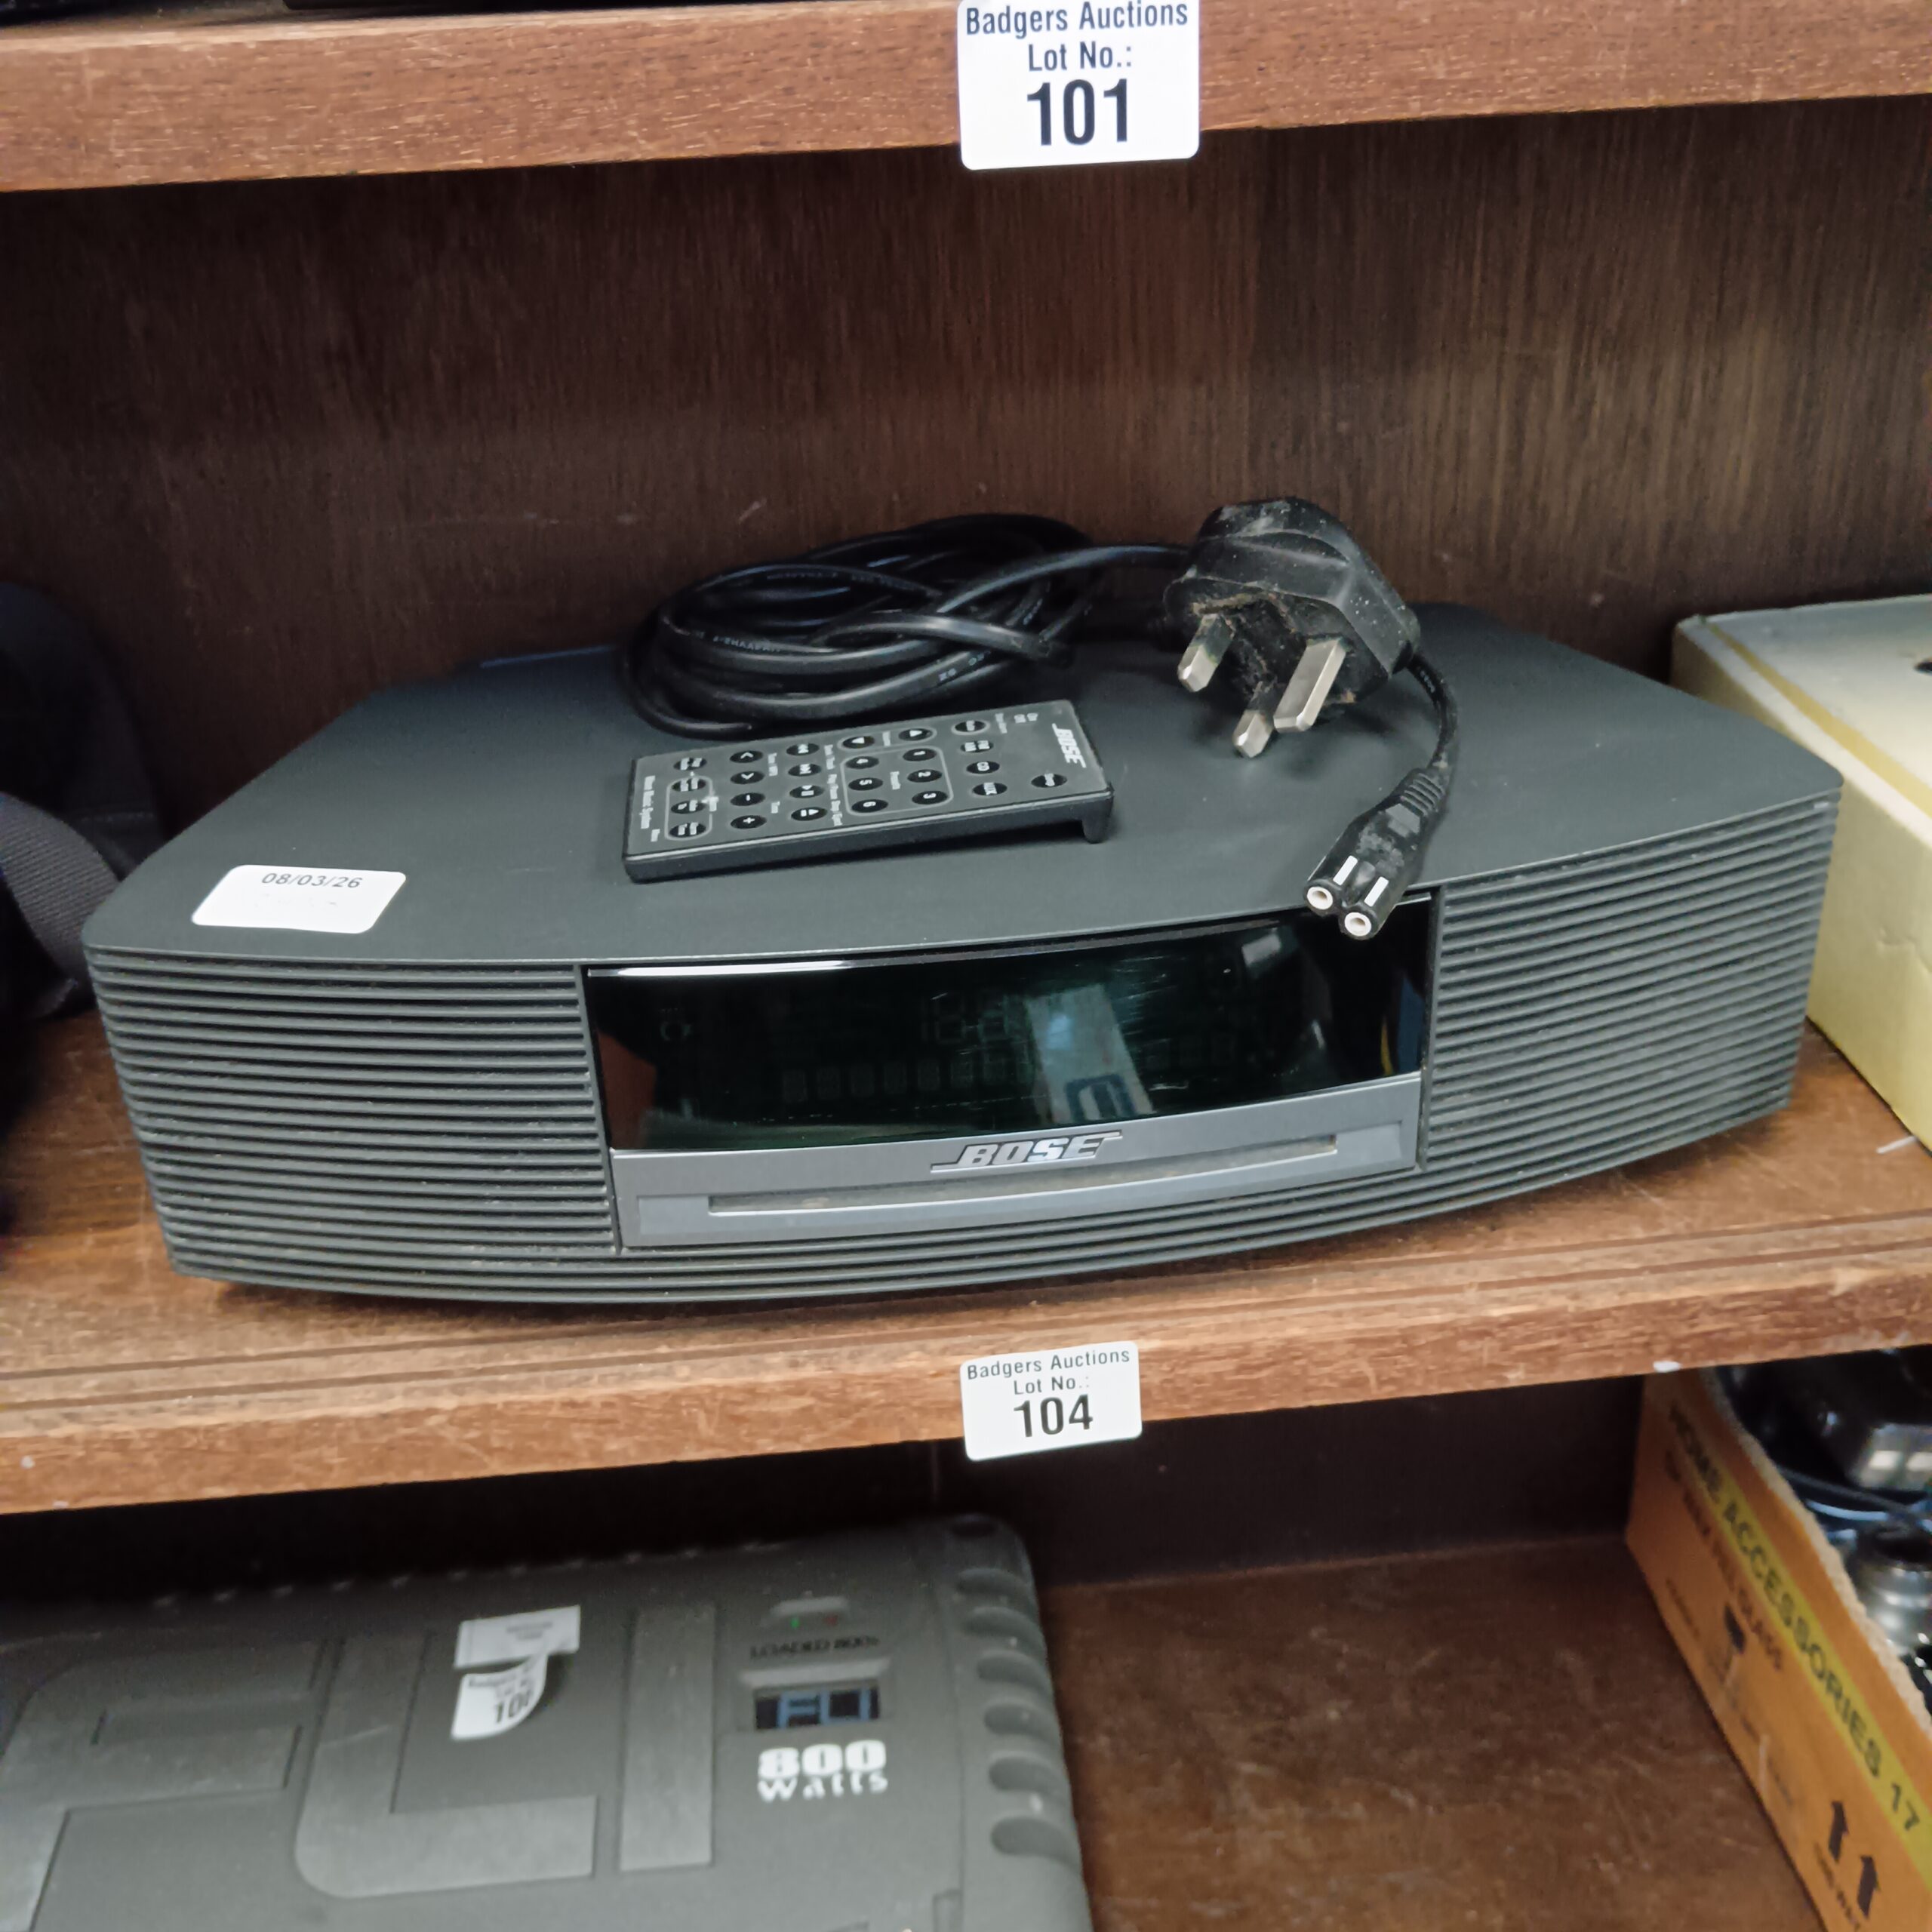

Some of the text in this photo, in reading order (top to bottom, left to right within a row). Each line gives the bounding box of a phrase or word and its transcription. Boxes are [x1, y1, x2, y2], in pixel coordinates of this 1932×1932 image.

[966, 0, 1188, 39] Badgers Auctions
[1028, 41, 1131, 71] Lot No.:
[1027, 78, 1128, 146] 101
[1051, 723, 1087, 768] BOSE
[260, 872, 363, 888] 08/03/26
[931, 1130, 1123, 1173] BOSE
[967, 1350, 1131, 1380] Badgers Auctions
[1014, 1379, 1042, 1395] Lot
[1014, 1394, 1094, 1437] 104
[1723, 1502, 1881, 1779] ACCESSORIES
[1892, 1783, 1920, 1831] 17
[758, 1740, 887, 1780] 800
